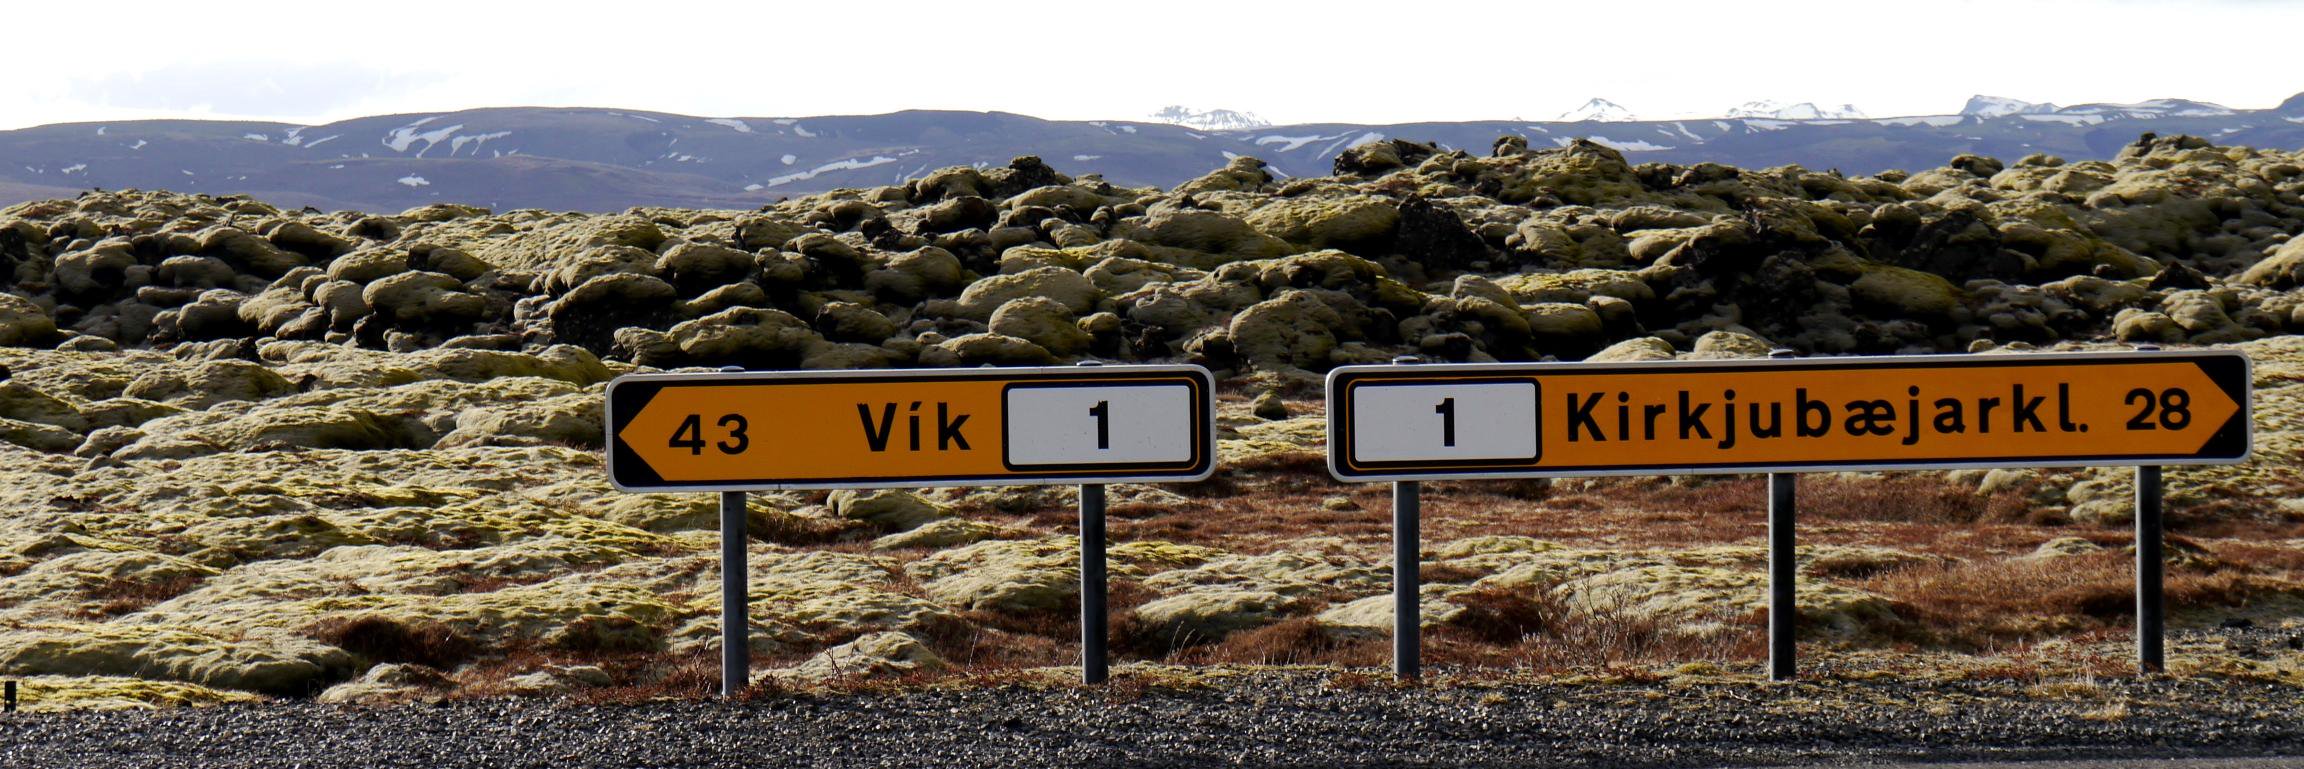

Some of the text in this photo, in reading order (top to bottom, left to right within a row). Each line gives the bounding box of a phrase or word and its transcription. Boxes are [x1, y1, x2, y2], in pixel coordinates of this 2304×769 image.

[668, 400, 1110, 456] 43 Vík 1
[1434, 383, 2192, 450] 1 Kirkjubæjarkl. 28
